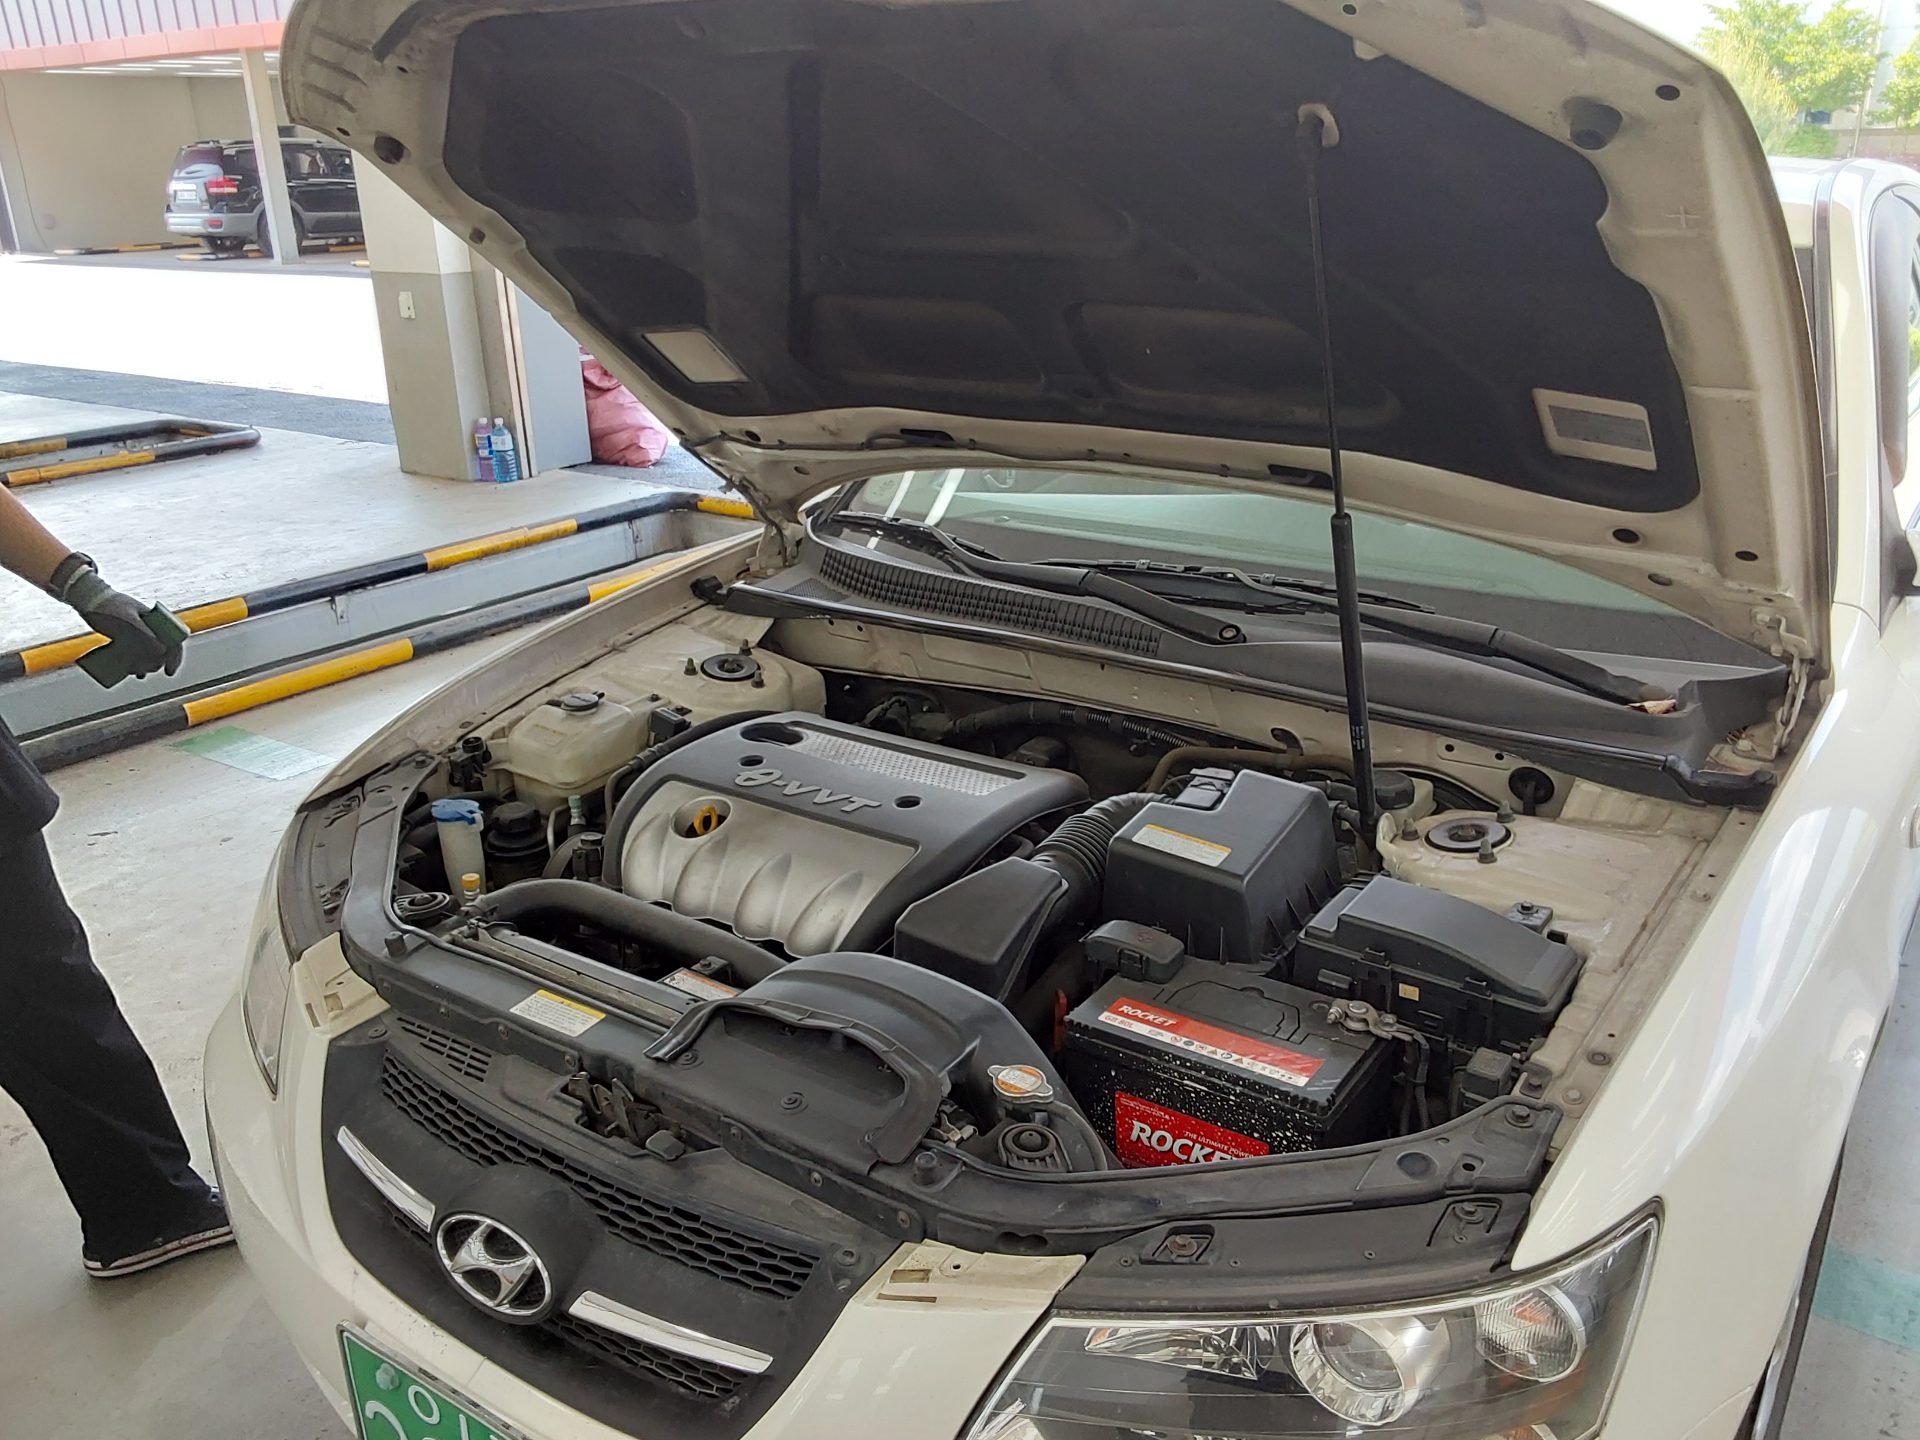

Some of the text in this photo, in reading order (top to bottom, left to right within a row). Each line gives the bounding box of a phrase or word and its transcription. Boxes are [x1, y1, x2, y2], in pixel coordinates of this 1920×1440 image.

[1118, 1005, 1176, 1026] ROCKET
[1130, 1119, 1238, 1164] ROCKE
[1183, 1131, 1198, 1140] THE
[1198, 1135, 1229, 1151] ULTIMATE
